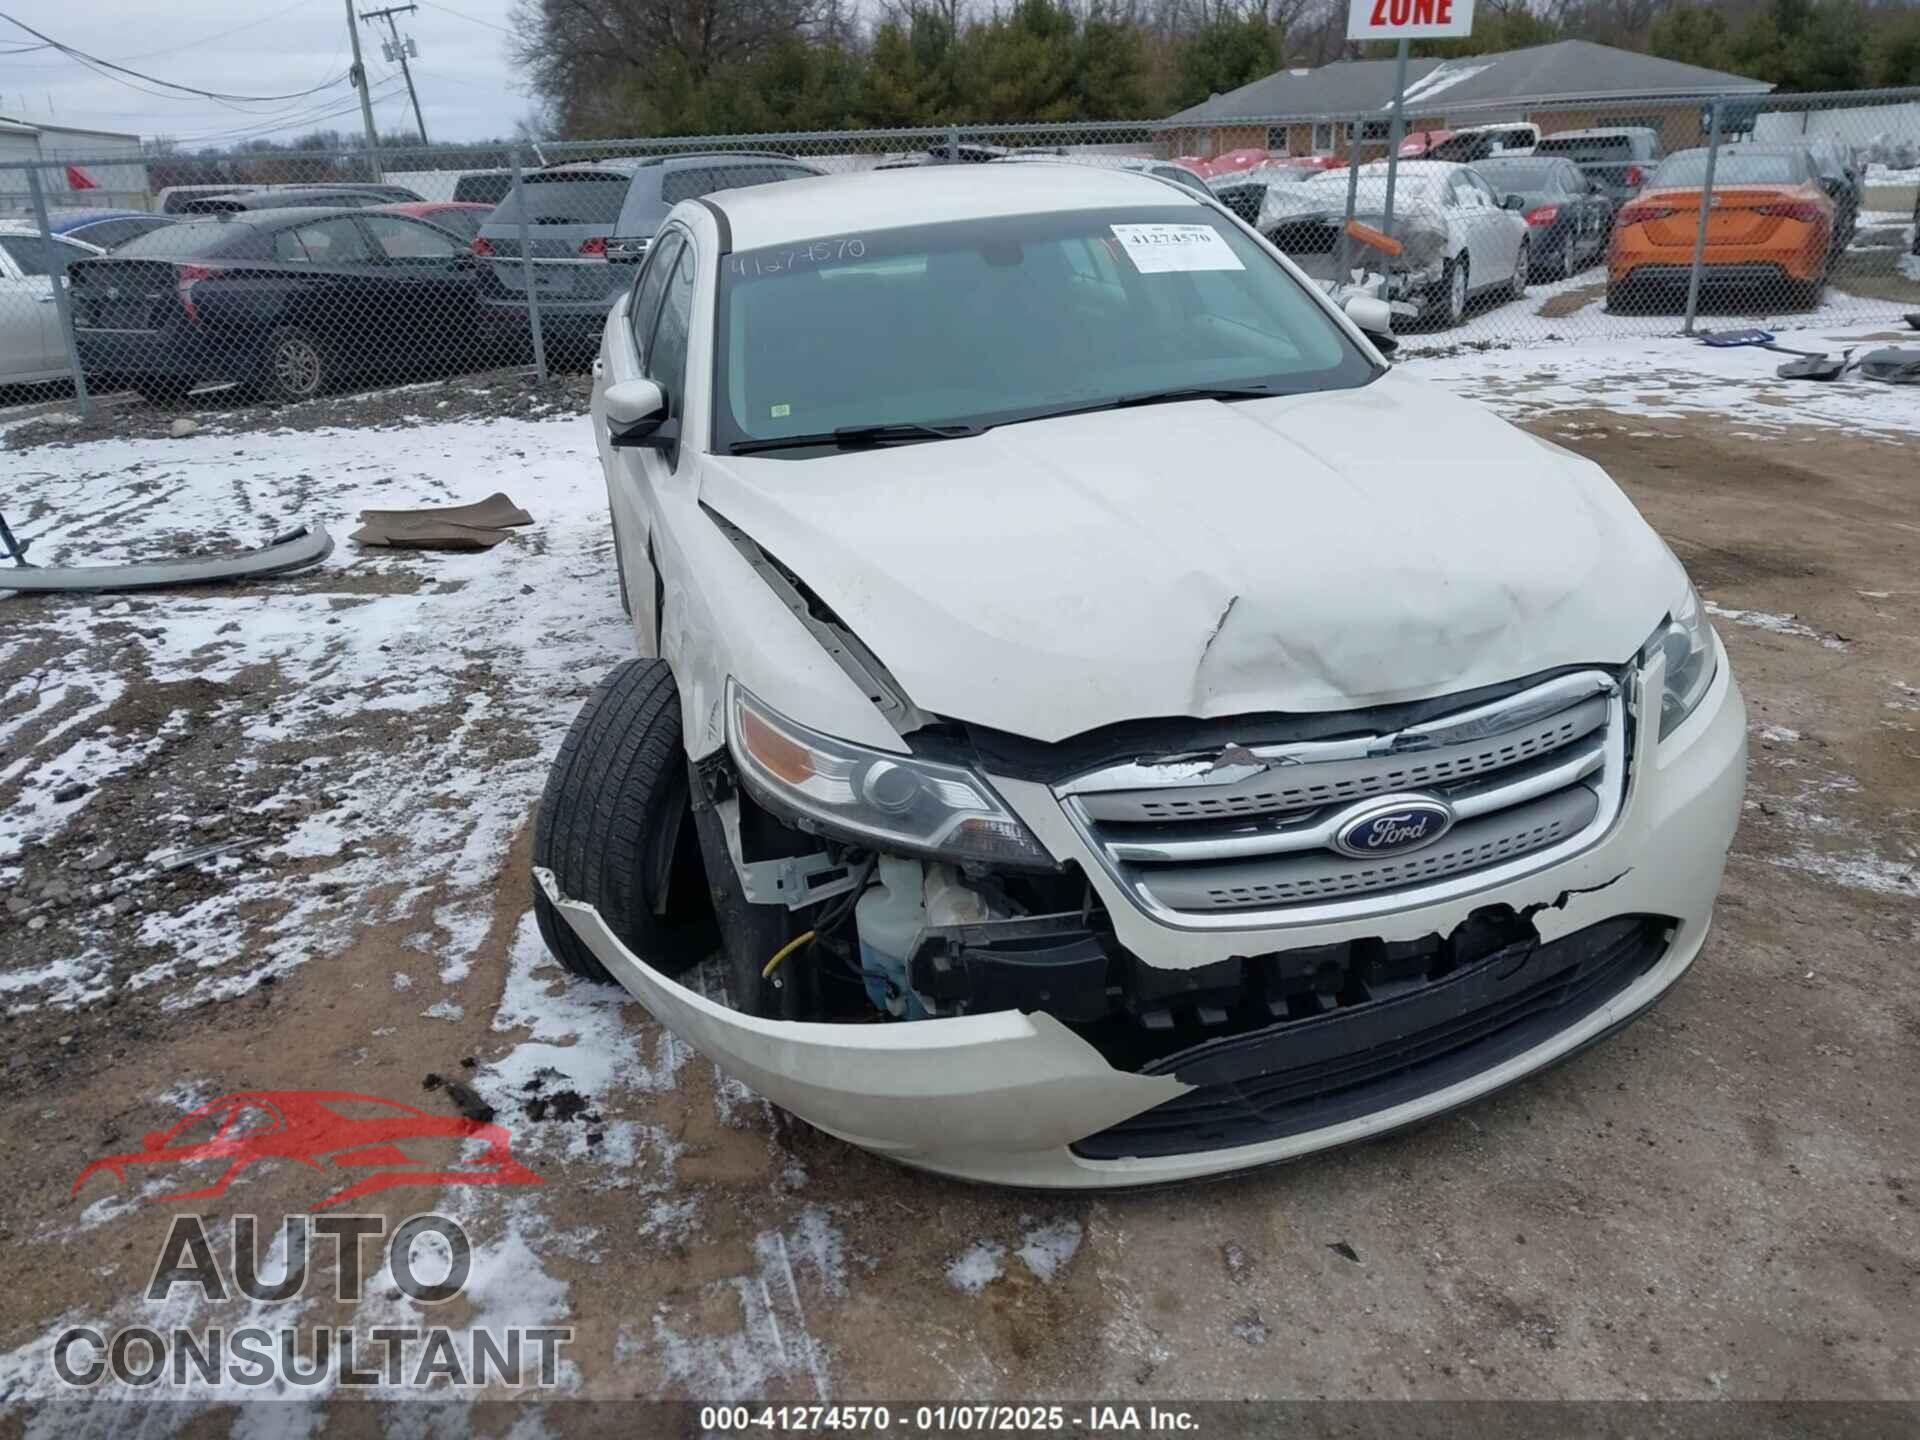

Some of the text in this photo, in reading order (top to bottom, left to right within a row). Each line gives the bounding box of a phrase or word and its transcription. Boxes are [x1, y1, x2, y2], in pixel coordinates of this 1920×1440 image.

[1370, 0, 1453, 26] ZONE
[1130, 232, 1212, 245] 41274570
[730, 239, 866, 277] 41274570
[1367, 813, 1428, 847] Ford
